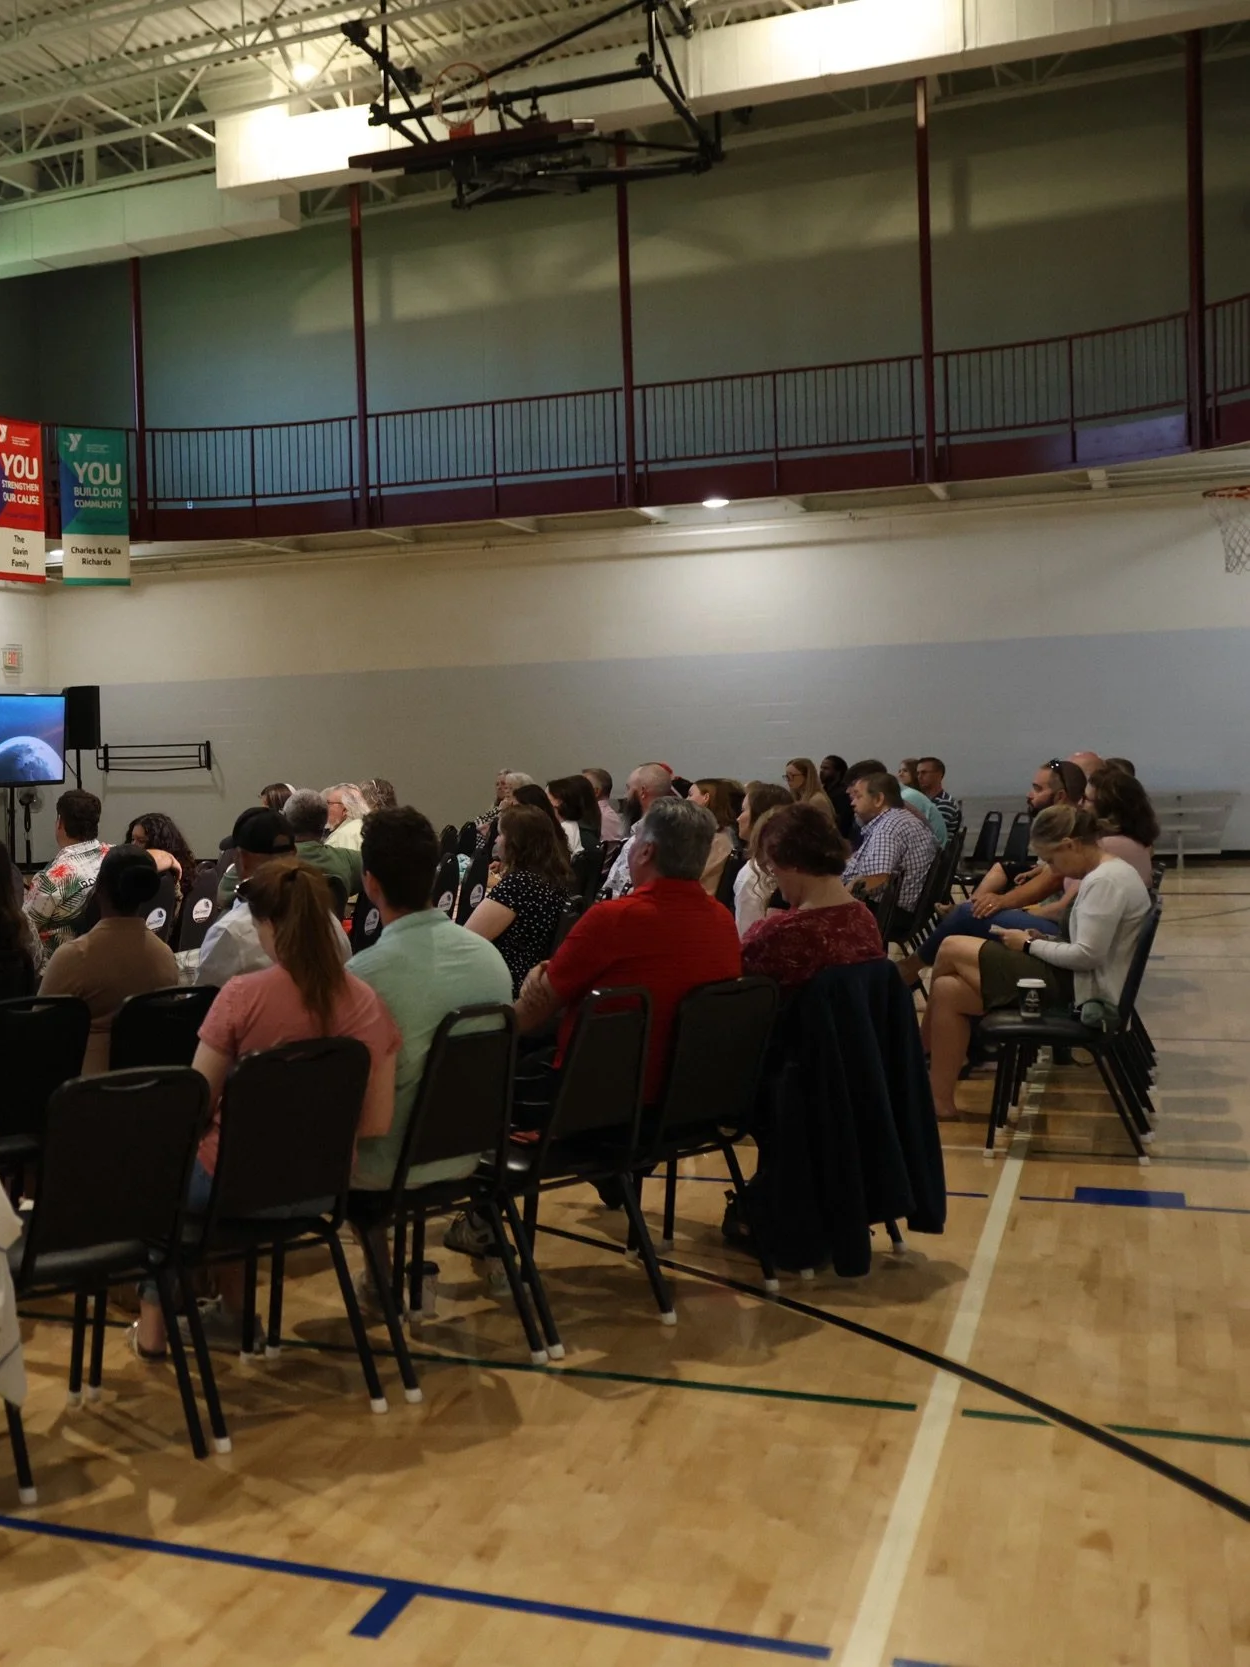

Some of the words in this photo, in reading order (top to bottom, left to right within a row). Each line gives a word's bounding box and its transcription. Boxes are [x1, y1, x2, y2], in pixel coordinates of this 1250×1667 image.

[1, 452, 39, 480] YOU
[73, 461, 122, 486] YOU
[1, 479, 39, 492] STRENGTHEN
[73, 486, 100, 497] BUILD
[101, 487, 122, 498] OUR
[2, 492, 16, 503] OUR
[17, 493, 40, 505] CAUSE
[74, 499, 123, 509] COMMUNITY
[14, 534, 25, 543] The
[12, 546, 28, 556] Gavin
[71, 546, 96, 555] Charles
[97, 547, 103, 555] &
[11, 559, 30, 570] Family
[81, 557, 111, 566] Richards
